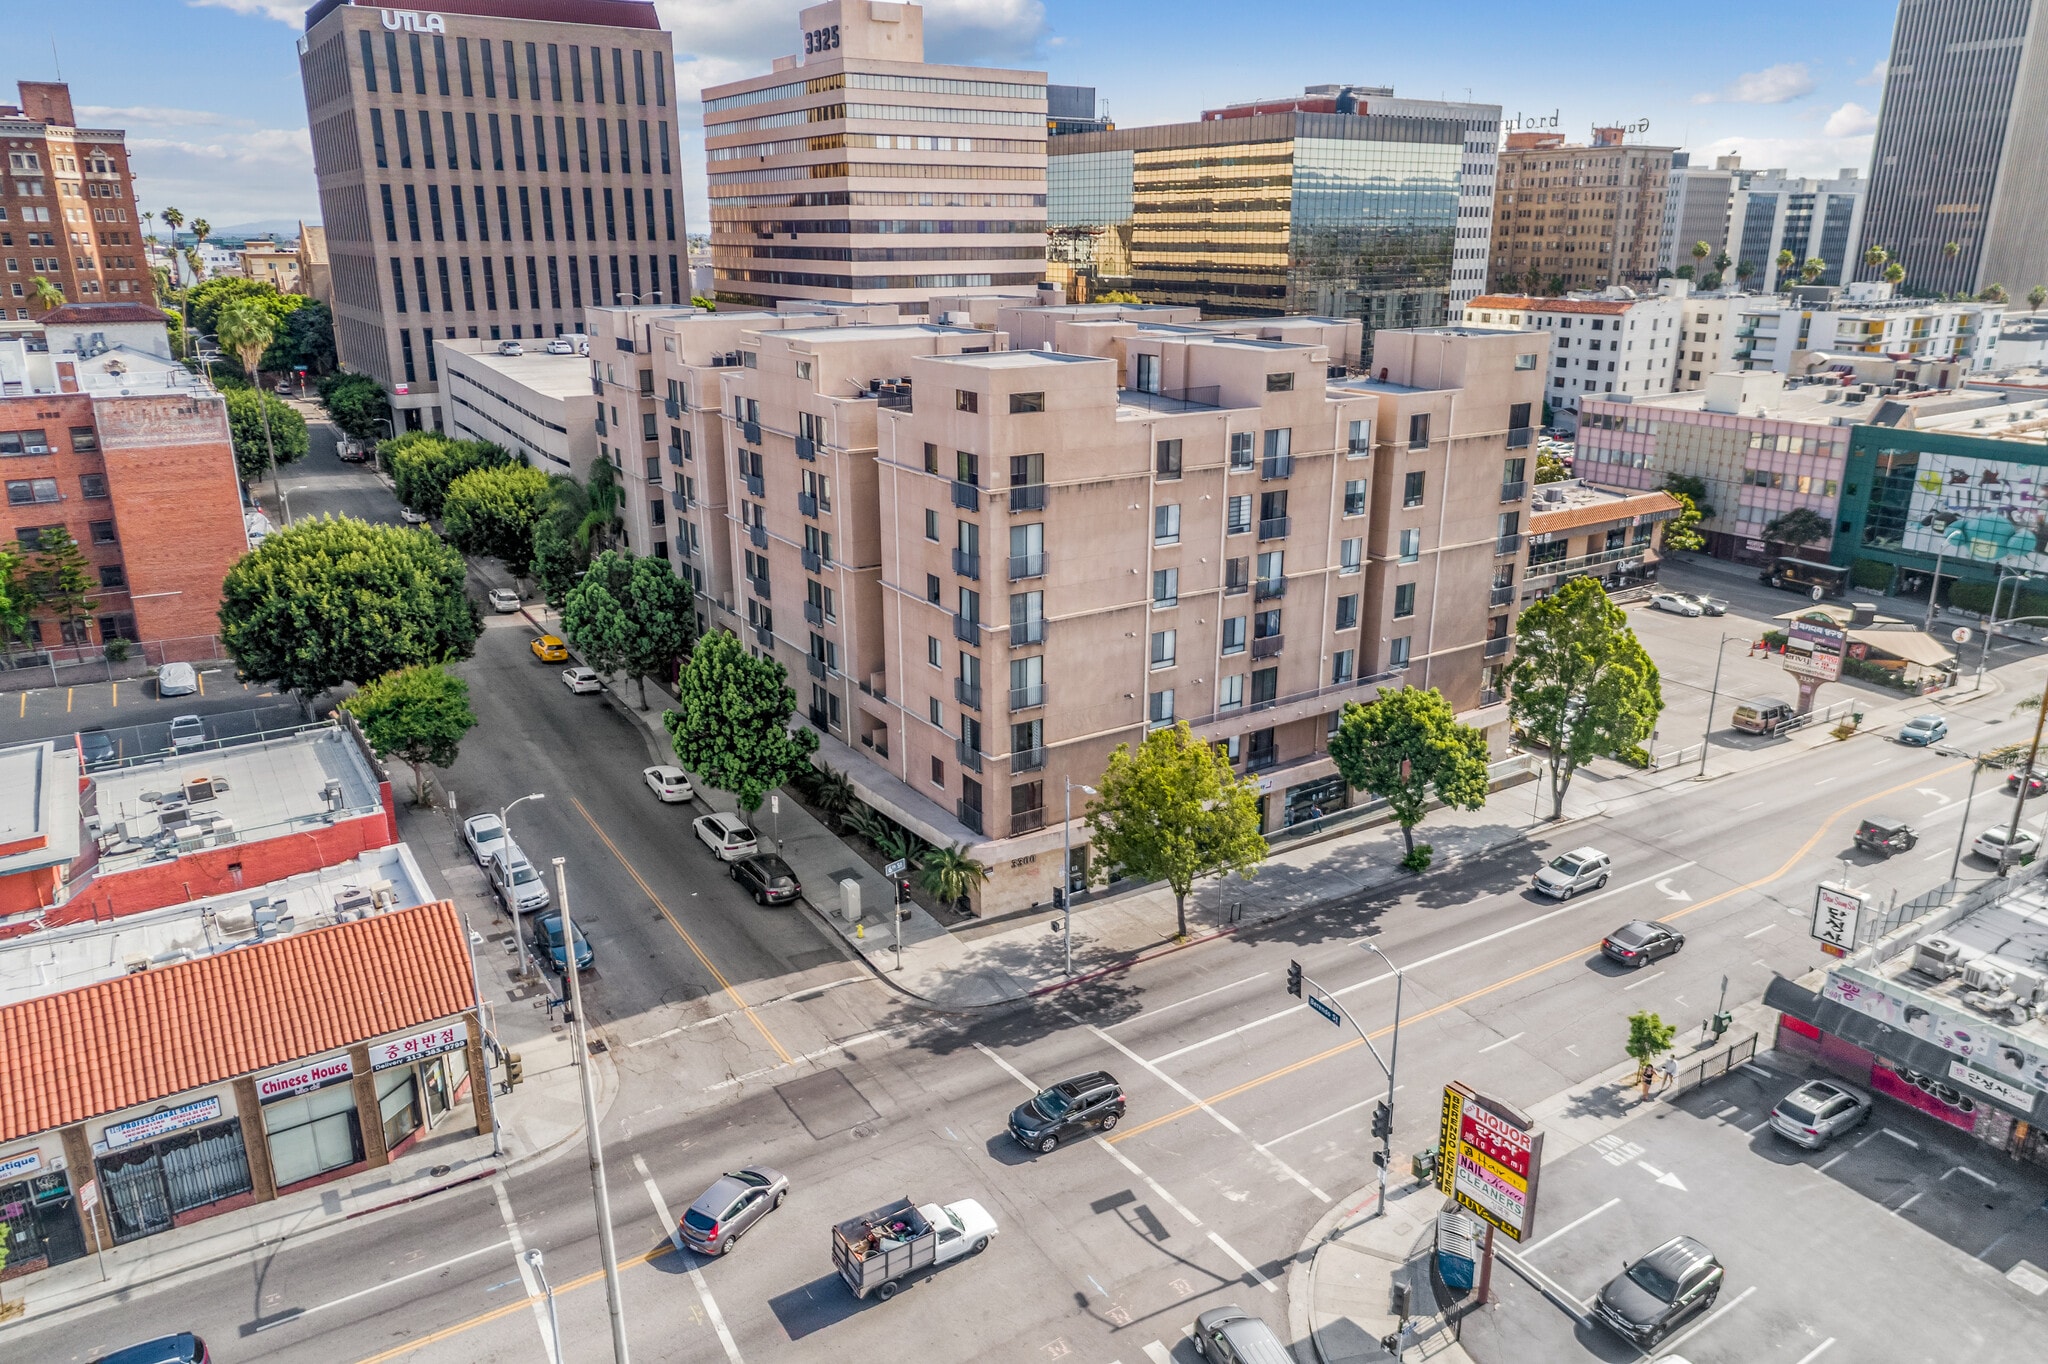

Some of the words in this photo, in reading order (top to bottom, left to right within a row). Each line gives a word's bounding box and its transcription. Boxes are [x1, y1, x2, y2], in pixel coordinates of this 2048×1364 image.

[381, 9, 446, 34] UTLA
[805, 25, 840, 54] 3325
[1502, 108, 1559, 134] ylord
[1822, 906, 1847, 943] 단성사
[384, 1028, 454, 1060] 중화반점
[262, 1074, 308, 1095] Chinese
[311, 1062, 348, 1081] House
[375, 1059, 404, 1071] Delivery
[1968, 1072, 2008, 1096] 단성사
[120, 1110, 178, 1130] PROFESSIONAL
[180, 1099, 216, 1114] SERVICES
[1448, 1096, 1460, 1148] BERENDO
[1475, 1107, 1531, 1150] LIQUOR
[1444, 1151, 1455, 1195] CENTER
[1460, 1155, 1483, 1178] NAIL
[1487, 1176, 1522, 1201] Korea
[1457, 1191, 1485, 1215] LUV
[1460, 1168, 1522, 1215] CLEANERS
